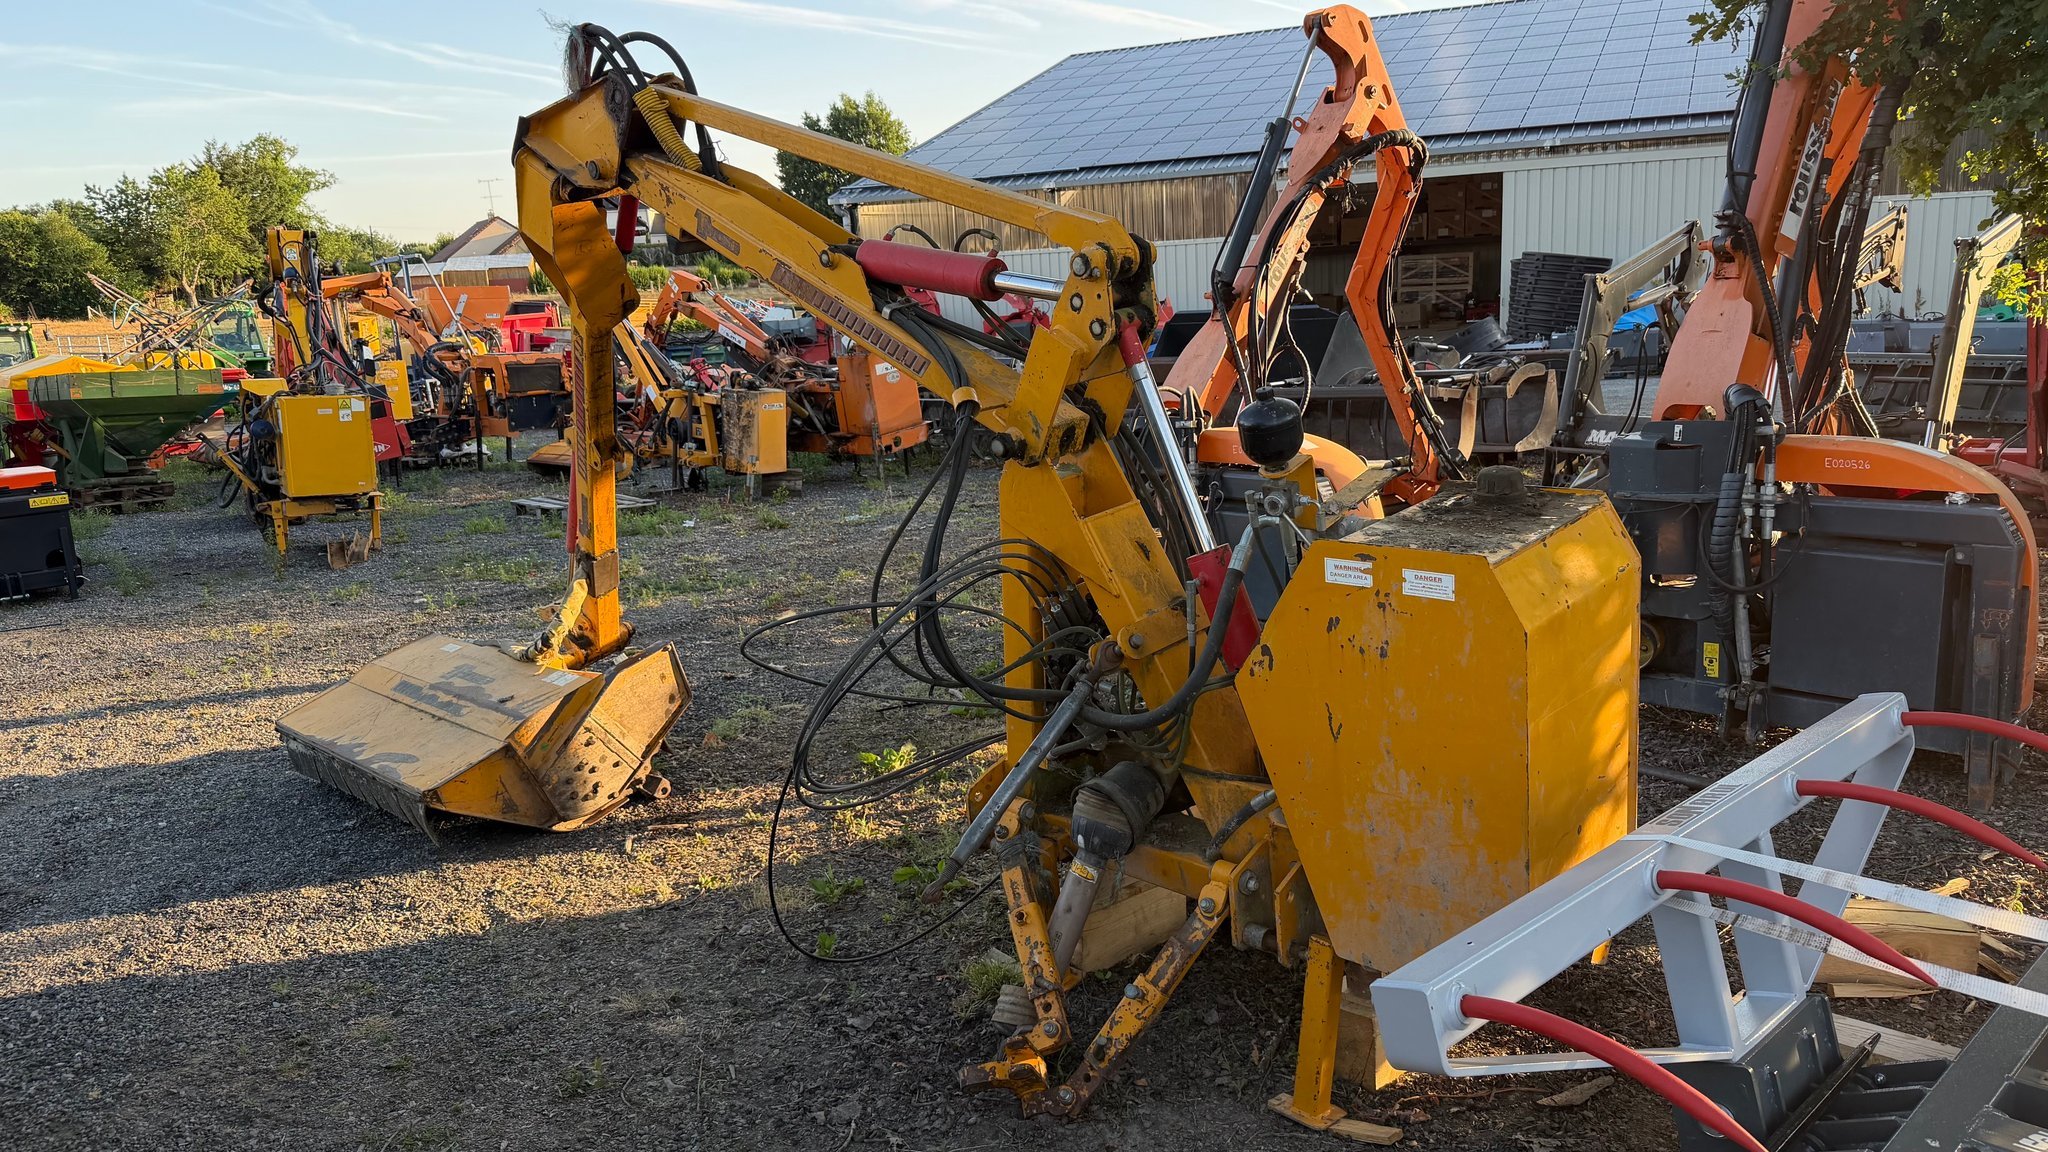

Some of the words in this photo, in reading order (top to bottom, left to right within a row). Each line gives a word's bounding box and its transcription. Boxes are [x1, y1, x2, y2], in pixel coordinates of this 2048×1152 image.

[1824, 457, 1871, 470] E020526
[1329, 571, 1353, 579] DANGER
[1414, 574, 1443, 583] DANGER
